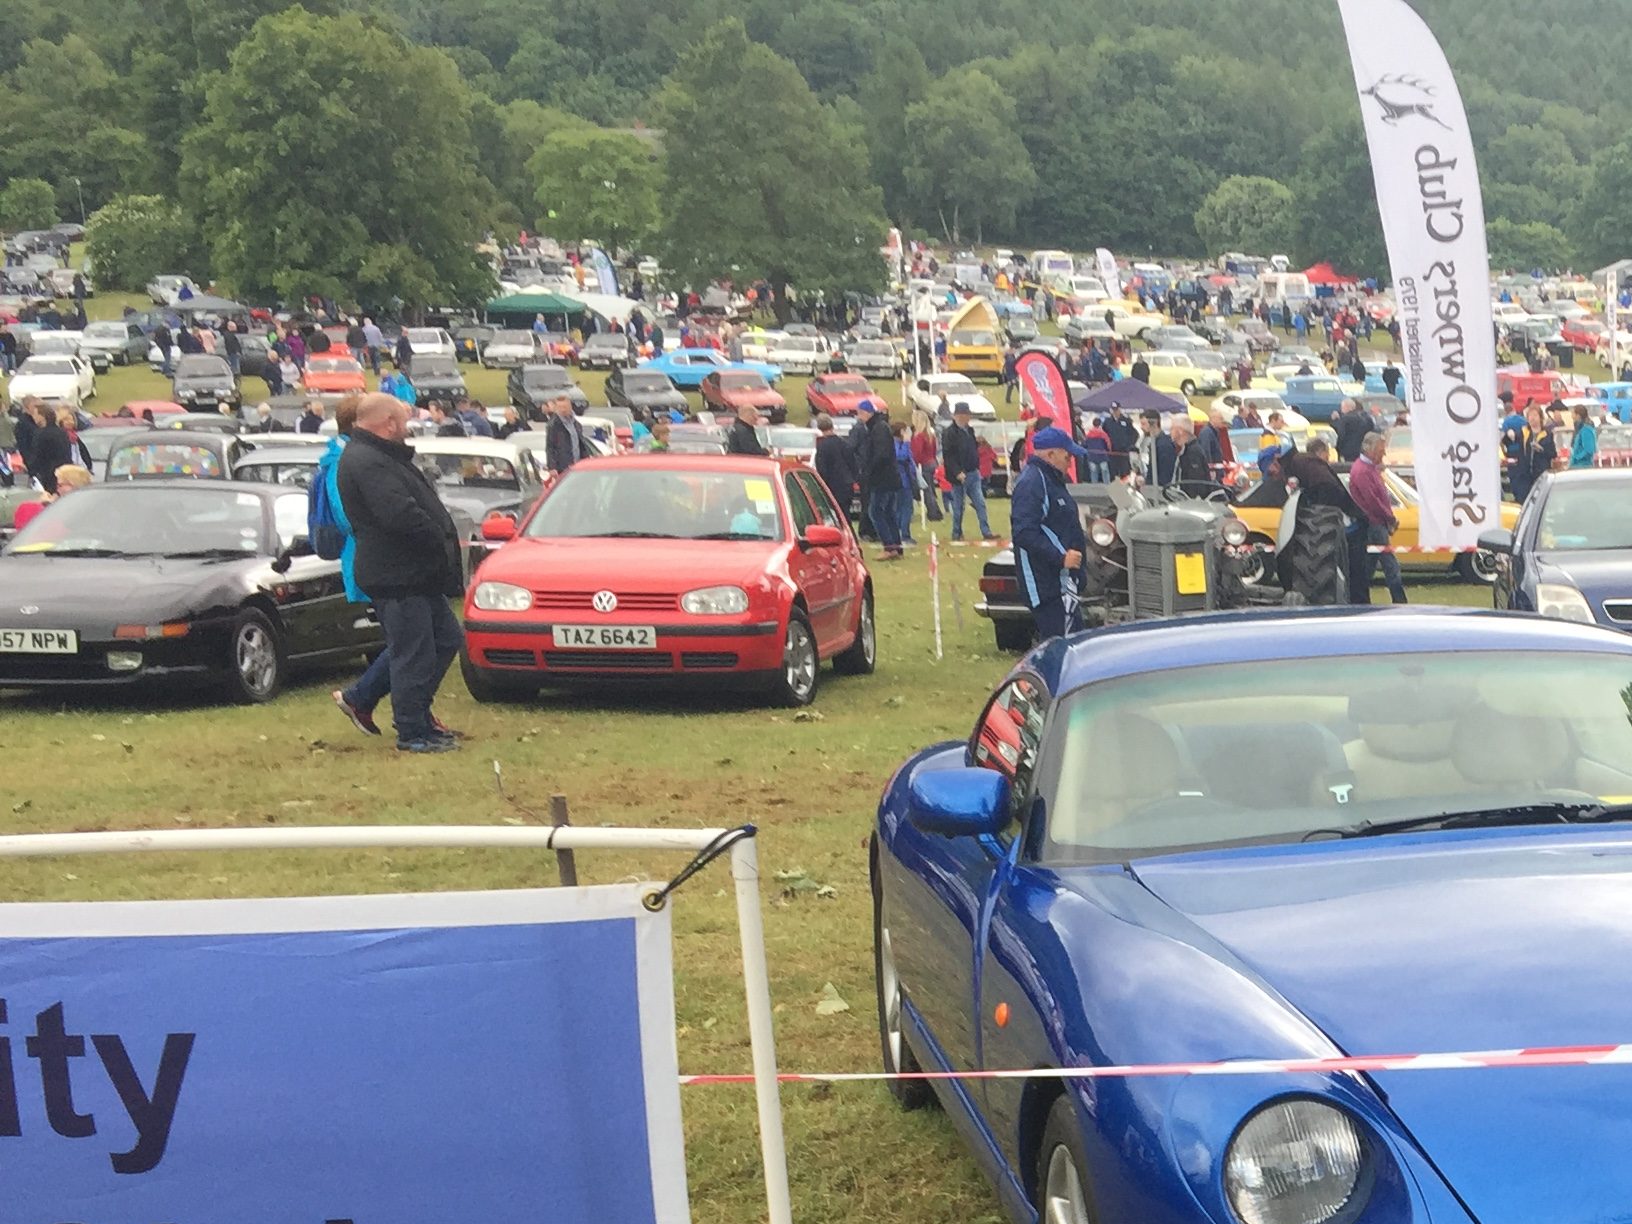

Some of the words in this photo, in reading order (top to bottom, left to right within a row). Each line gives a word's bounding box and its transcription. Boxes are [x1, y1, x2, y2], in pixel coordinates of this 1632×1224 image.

[0, 631, 25, 649] 57
[31, 631, 68, 650] NPW
[560, 627, 597, 645] TAZ
[600, 628, 649, 646] 6642
